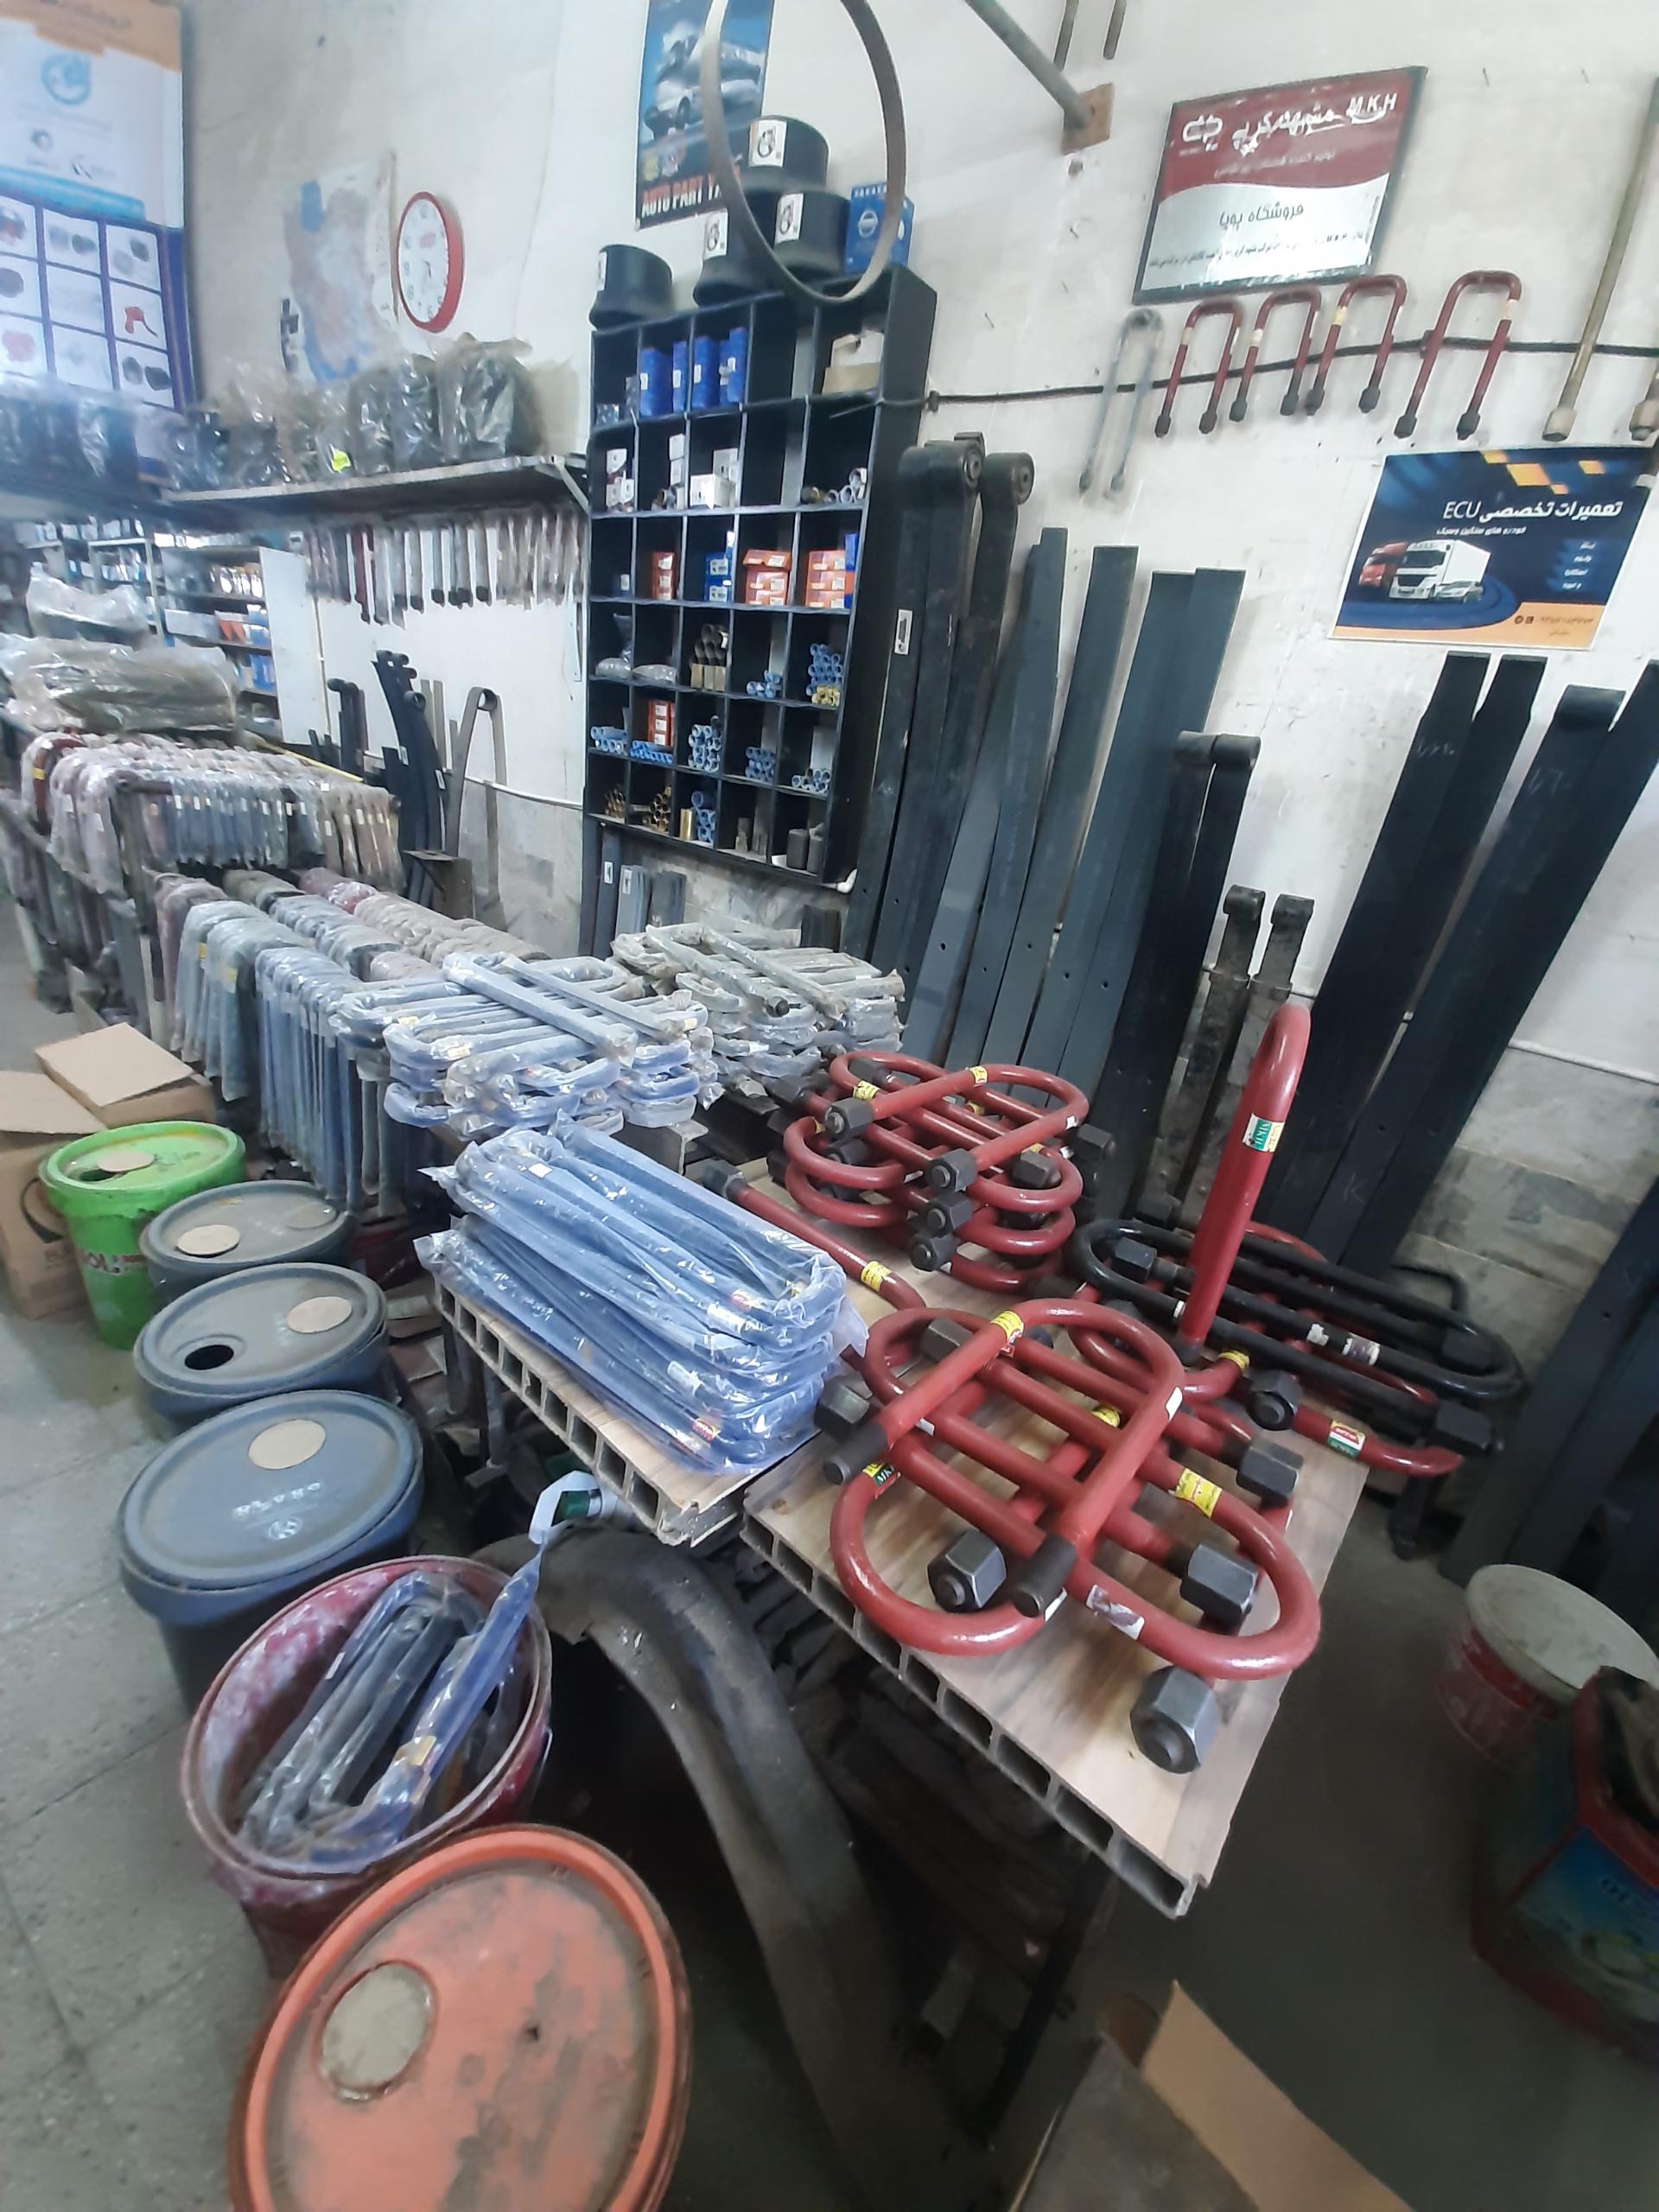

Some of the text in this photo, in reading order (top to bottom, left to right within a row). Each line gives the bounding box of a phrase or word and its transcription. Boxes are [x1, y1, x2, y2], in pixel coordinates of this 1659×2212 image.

[642, 183, 671, 219] AUTO
[671, 174, 703, 210] PART
[1219, 201, 1304, 231] فروشگاه پویا
[1443, 500, 1624, 523] تعمیرات تخصصی ECU
